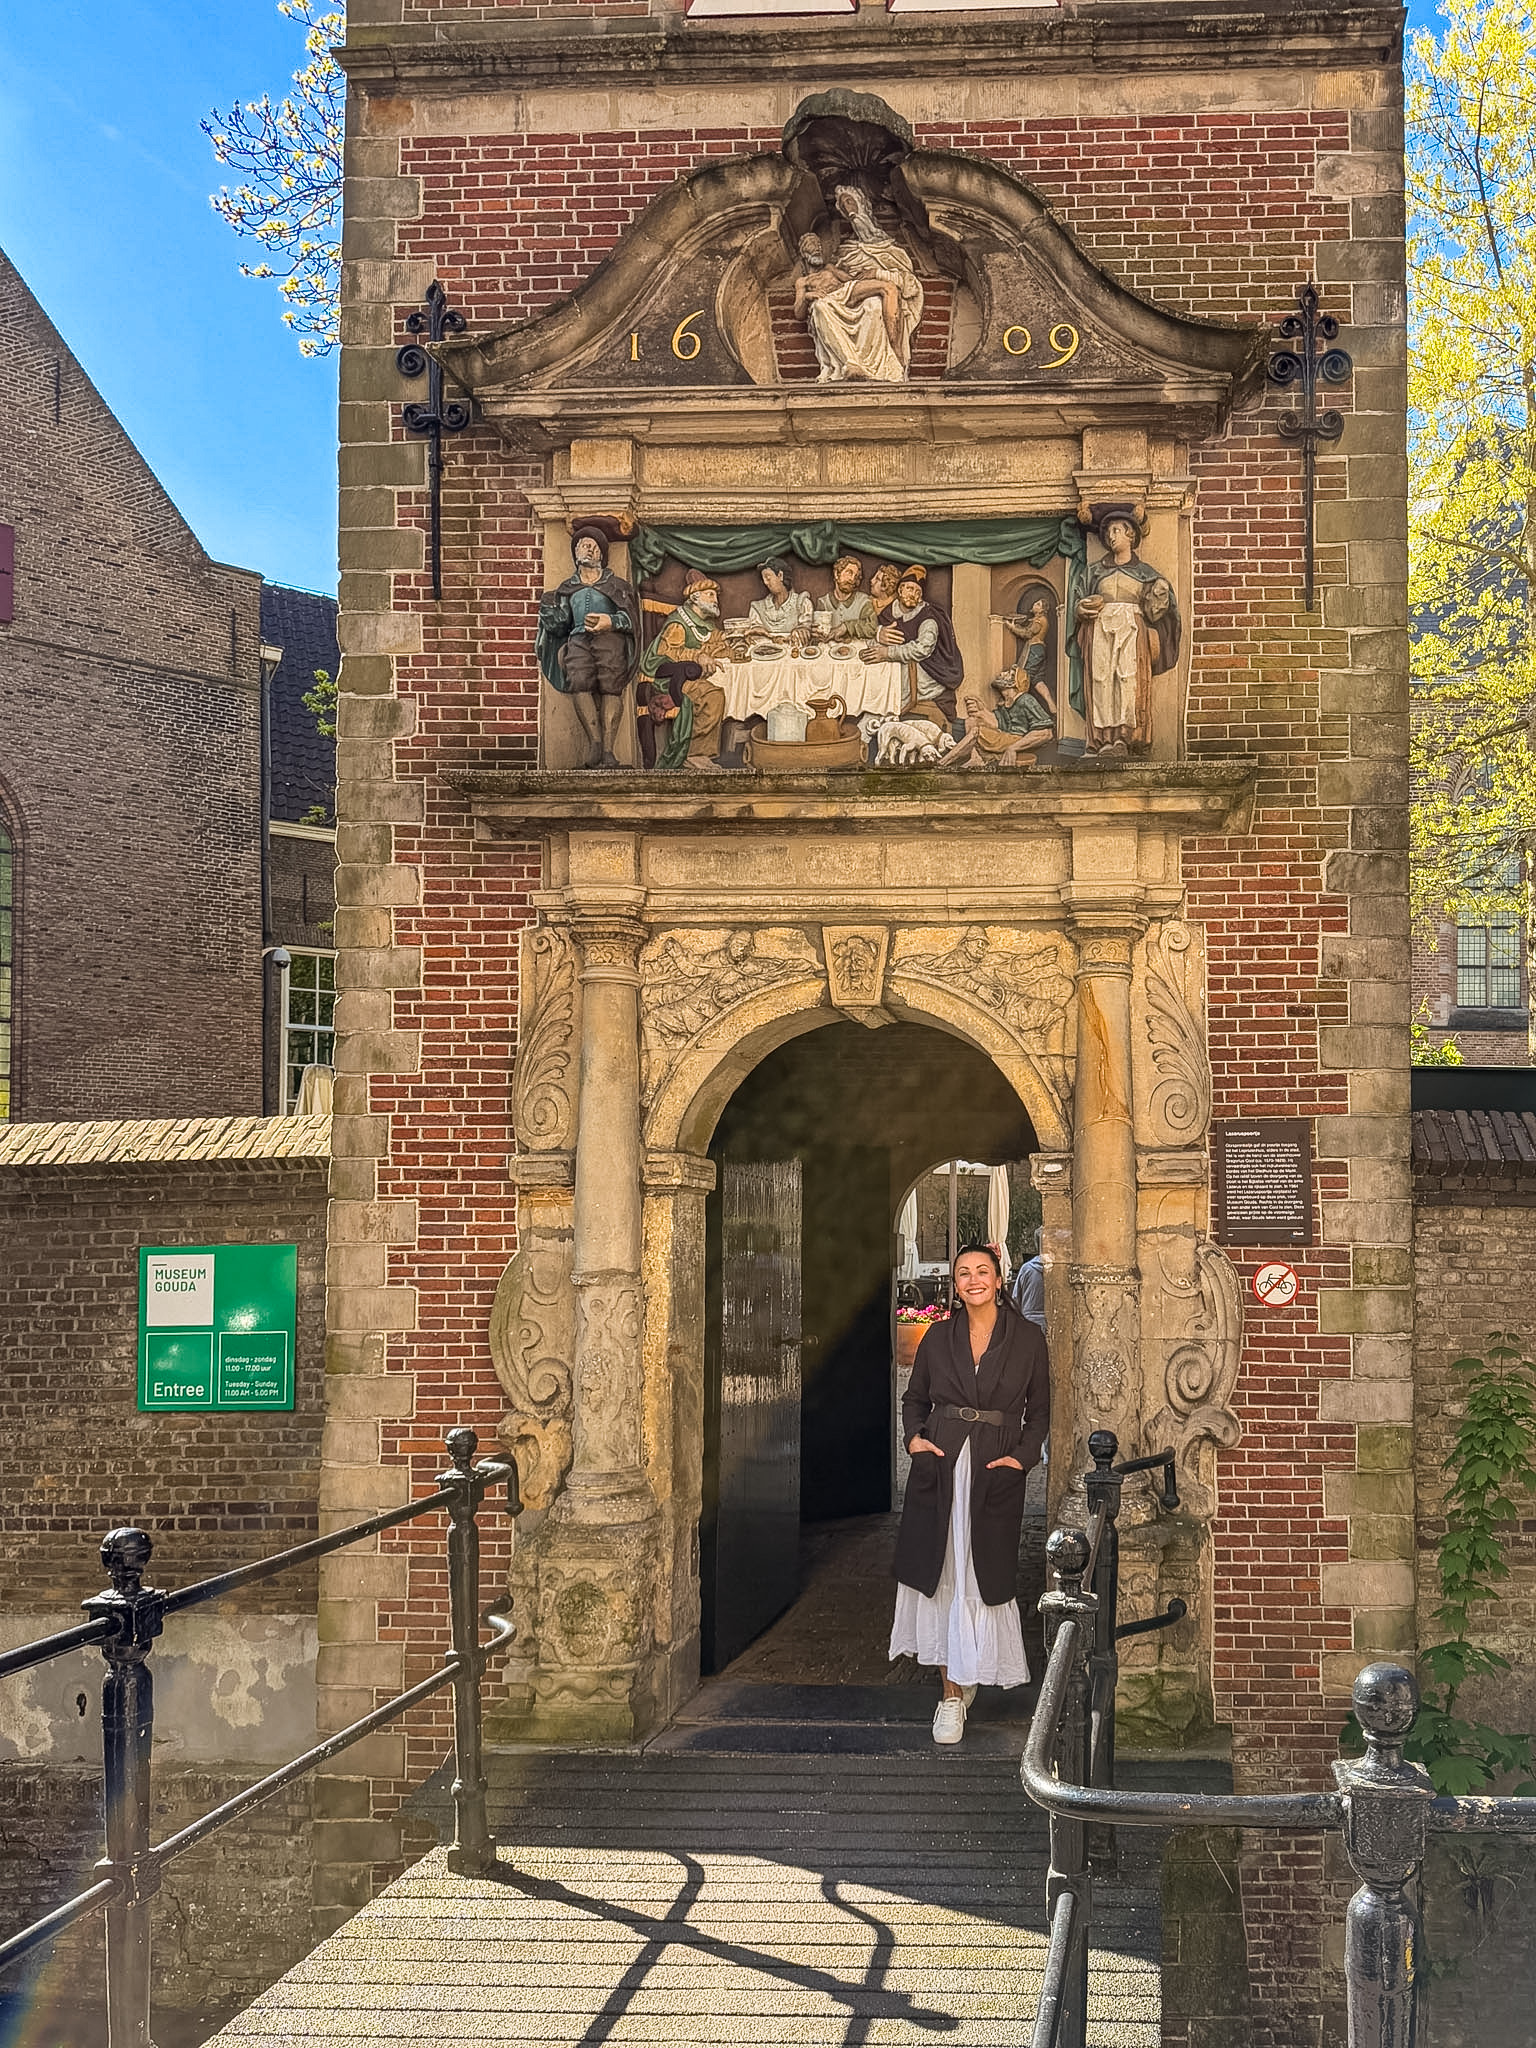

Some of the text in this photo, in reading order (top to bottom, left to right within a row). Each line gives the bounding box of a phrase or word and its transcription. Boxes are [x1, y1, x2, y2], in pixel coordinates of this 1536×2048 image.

[154, 1268, 206, 1280] MUSEUM
[154, 1281, 197, 1292] GOUDA
[153, 1382, 205, 1397] Entree
[224, 1381, 250, 1389] Tuesday
